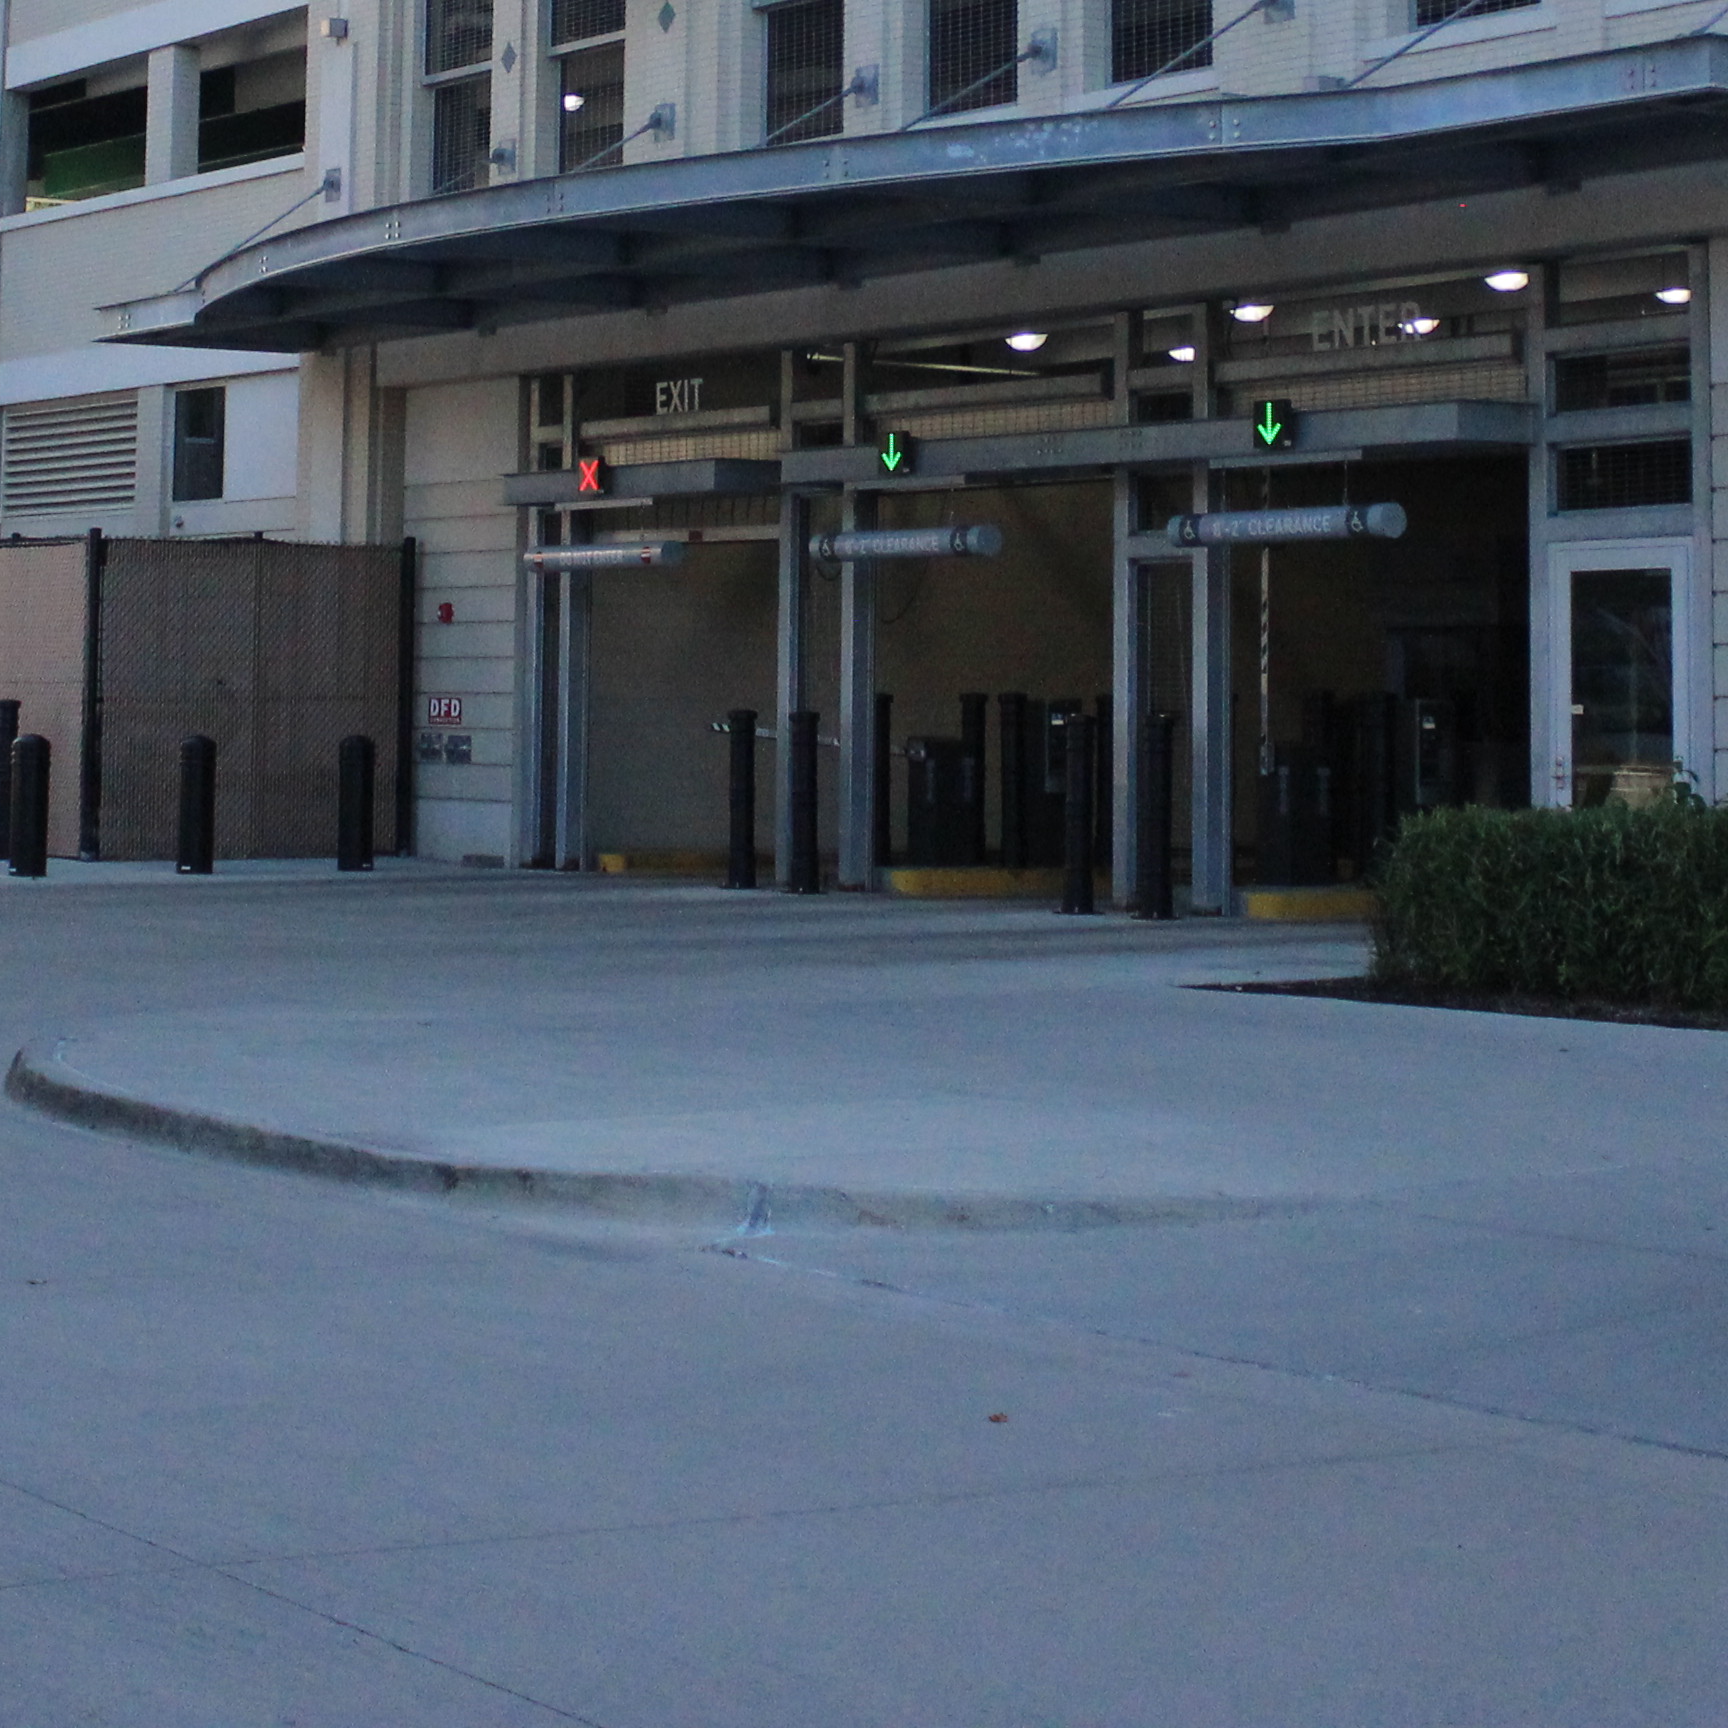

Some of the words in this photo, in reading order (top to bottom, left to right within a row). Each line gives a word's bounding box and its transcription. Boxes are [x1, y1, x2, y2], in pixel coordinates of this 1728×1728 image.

[1311, 301, 1422, 352] ENTER
[656, 378, 704, 416] EXIT
[1247, 514, 1332, 536] CLEARANCE
[872, 534, 940, 554] CLEARANCE
[430, 698, 461, 718] DFD
